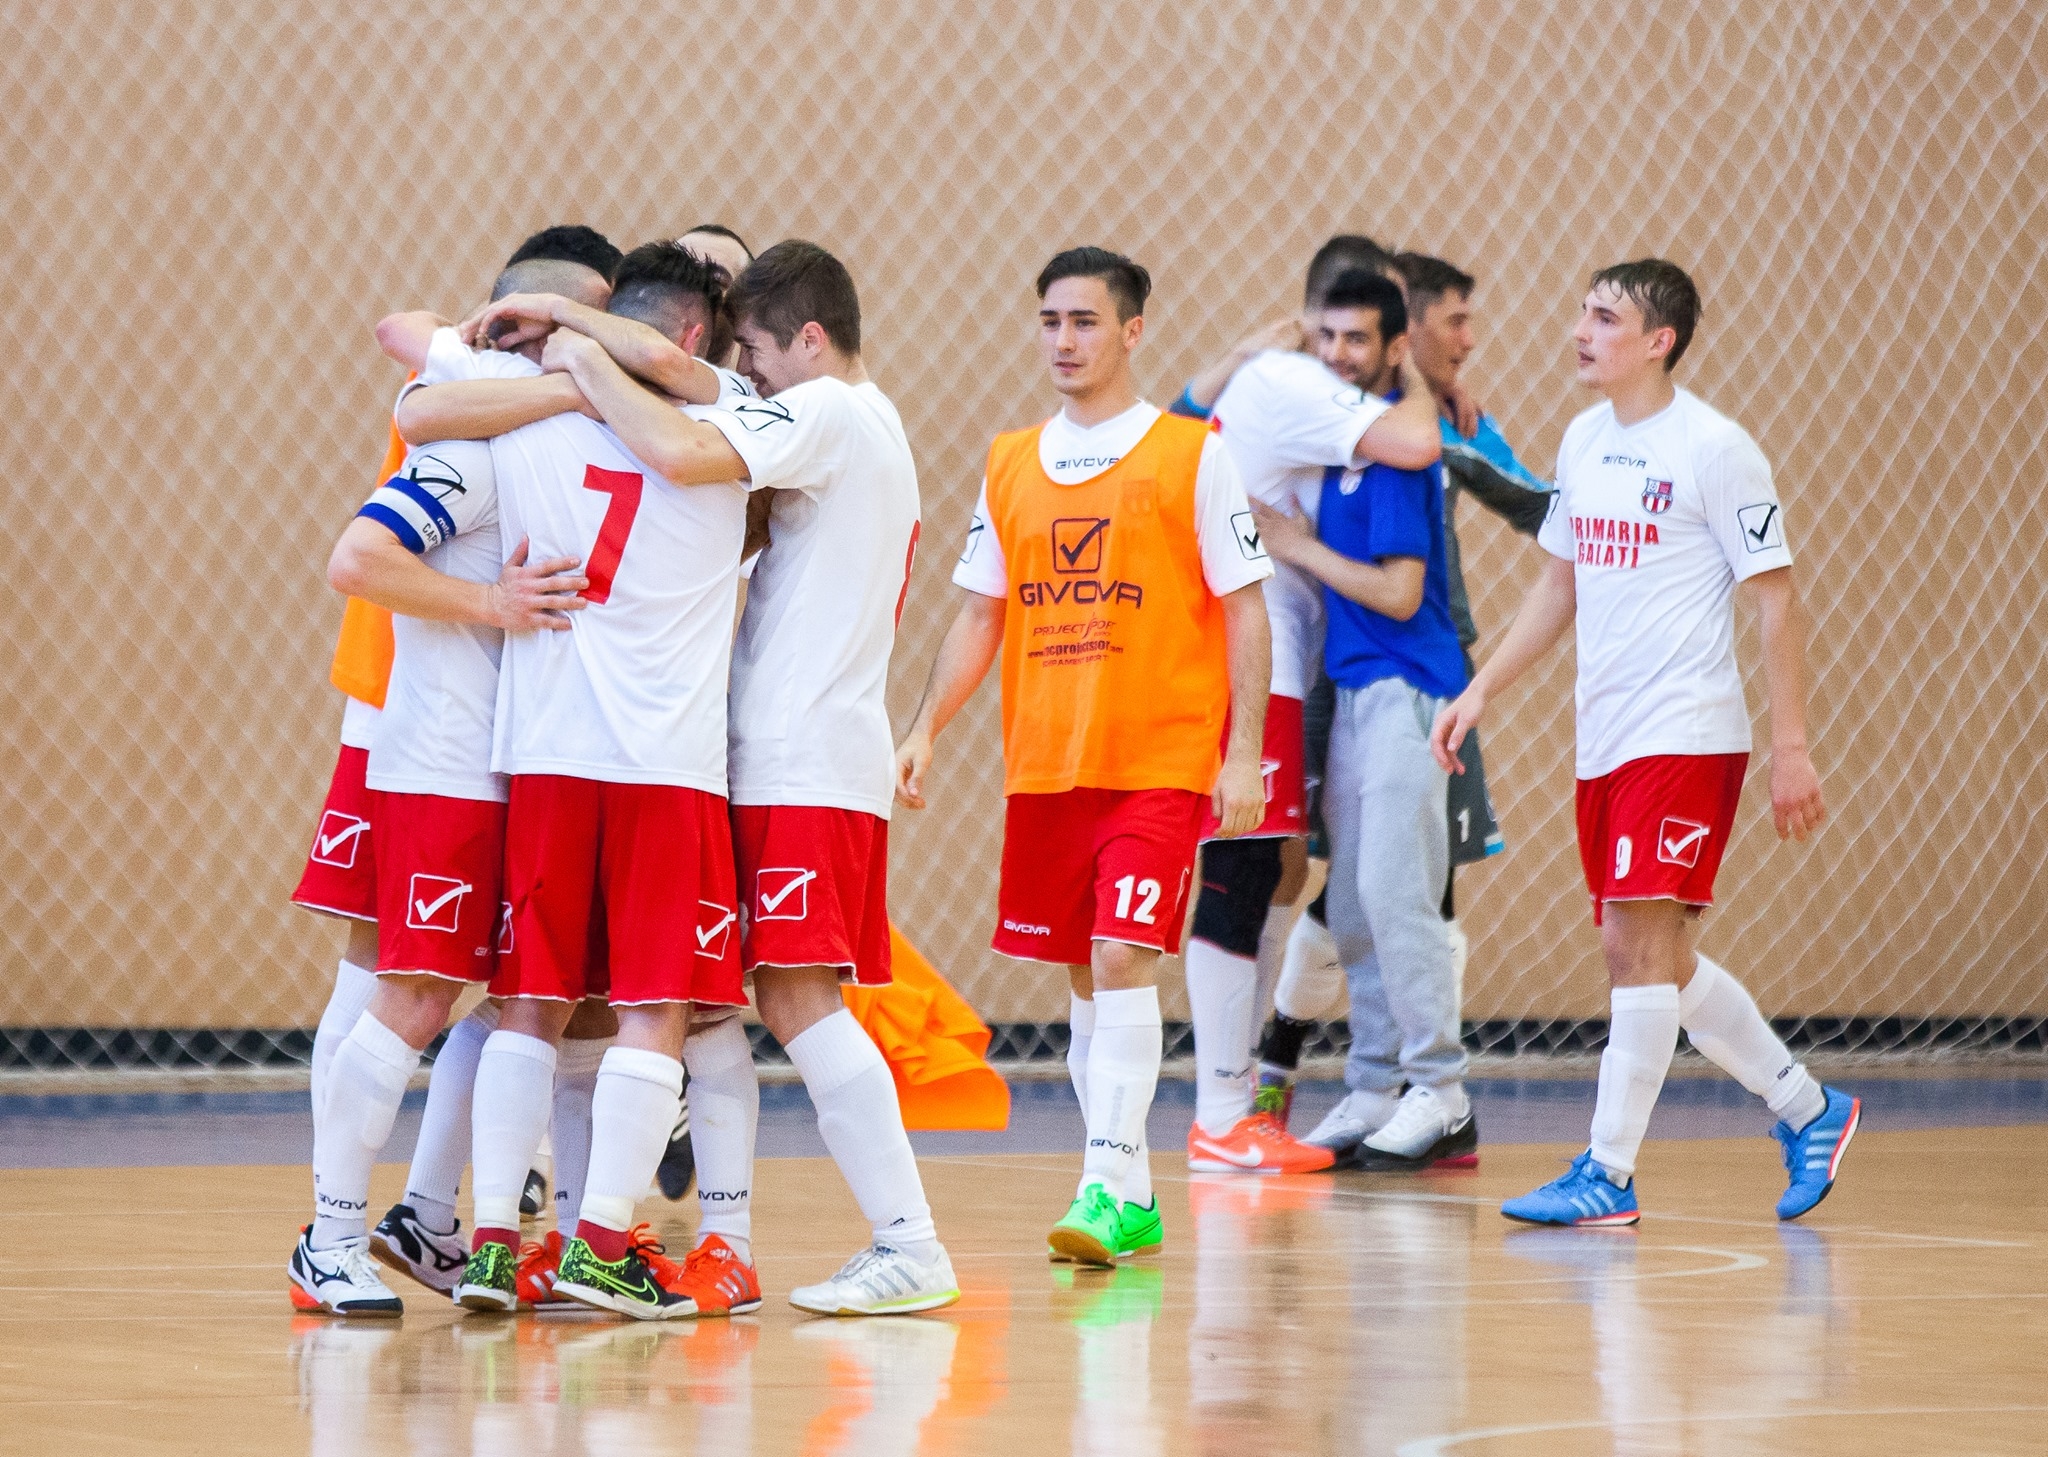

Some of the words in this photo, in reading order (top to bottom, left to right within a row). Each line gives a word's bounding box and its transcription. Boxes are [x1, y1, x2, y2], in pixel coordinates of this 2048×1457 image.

[576, 464, 643, 605] 7
[1577, 542, 1639, 569] GALATI
[1019, 580, 1143, 609] GIVOVA
[1458, 808, 1471, 843] 1
[1614, 836, 1633, 880] 9
[1114, 875, 1162, 925] 12
[1003, 919, 1050, 936] GIVOVA
